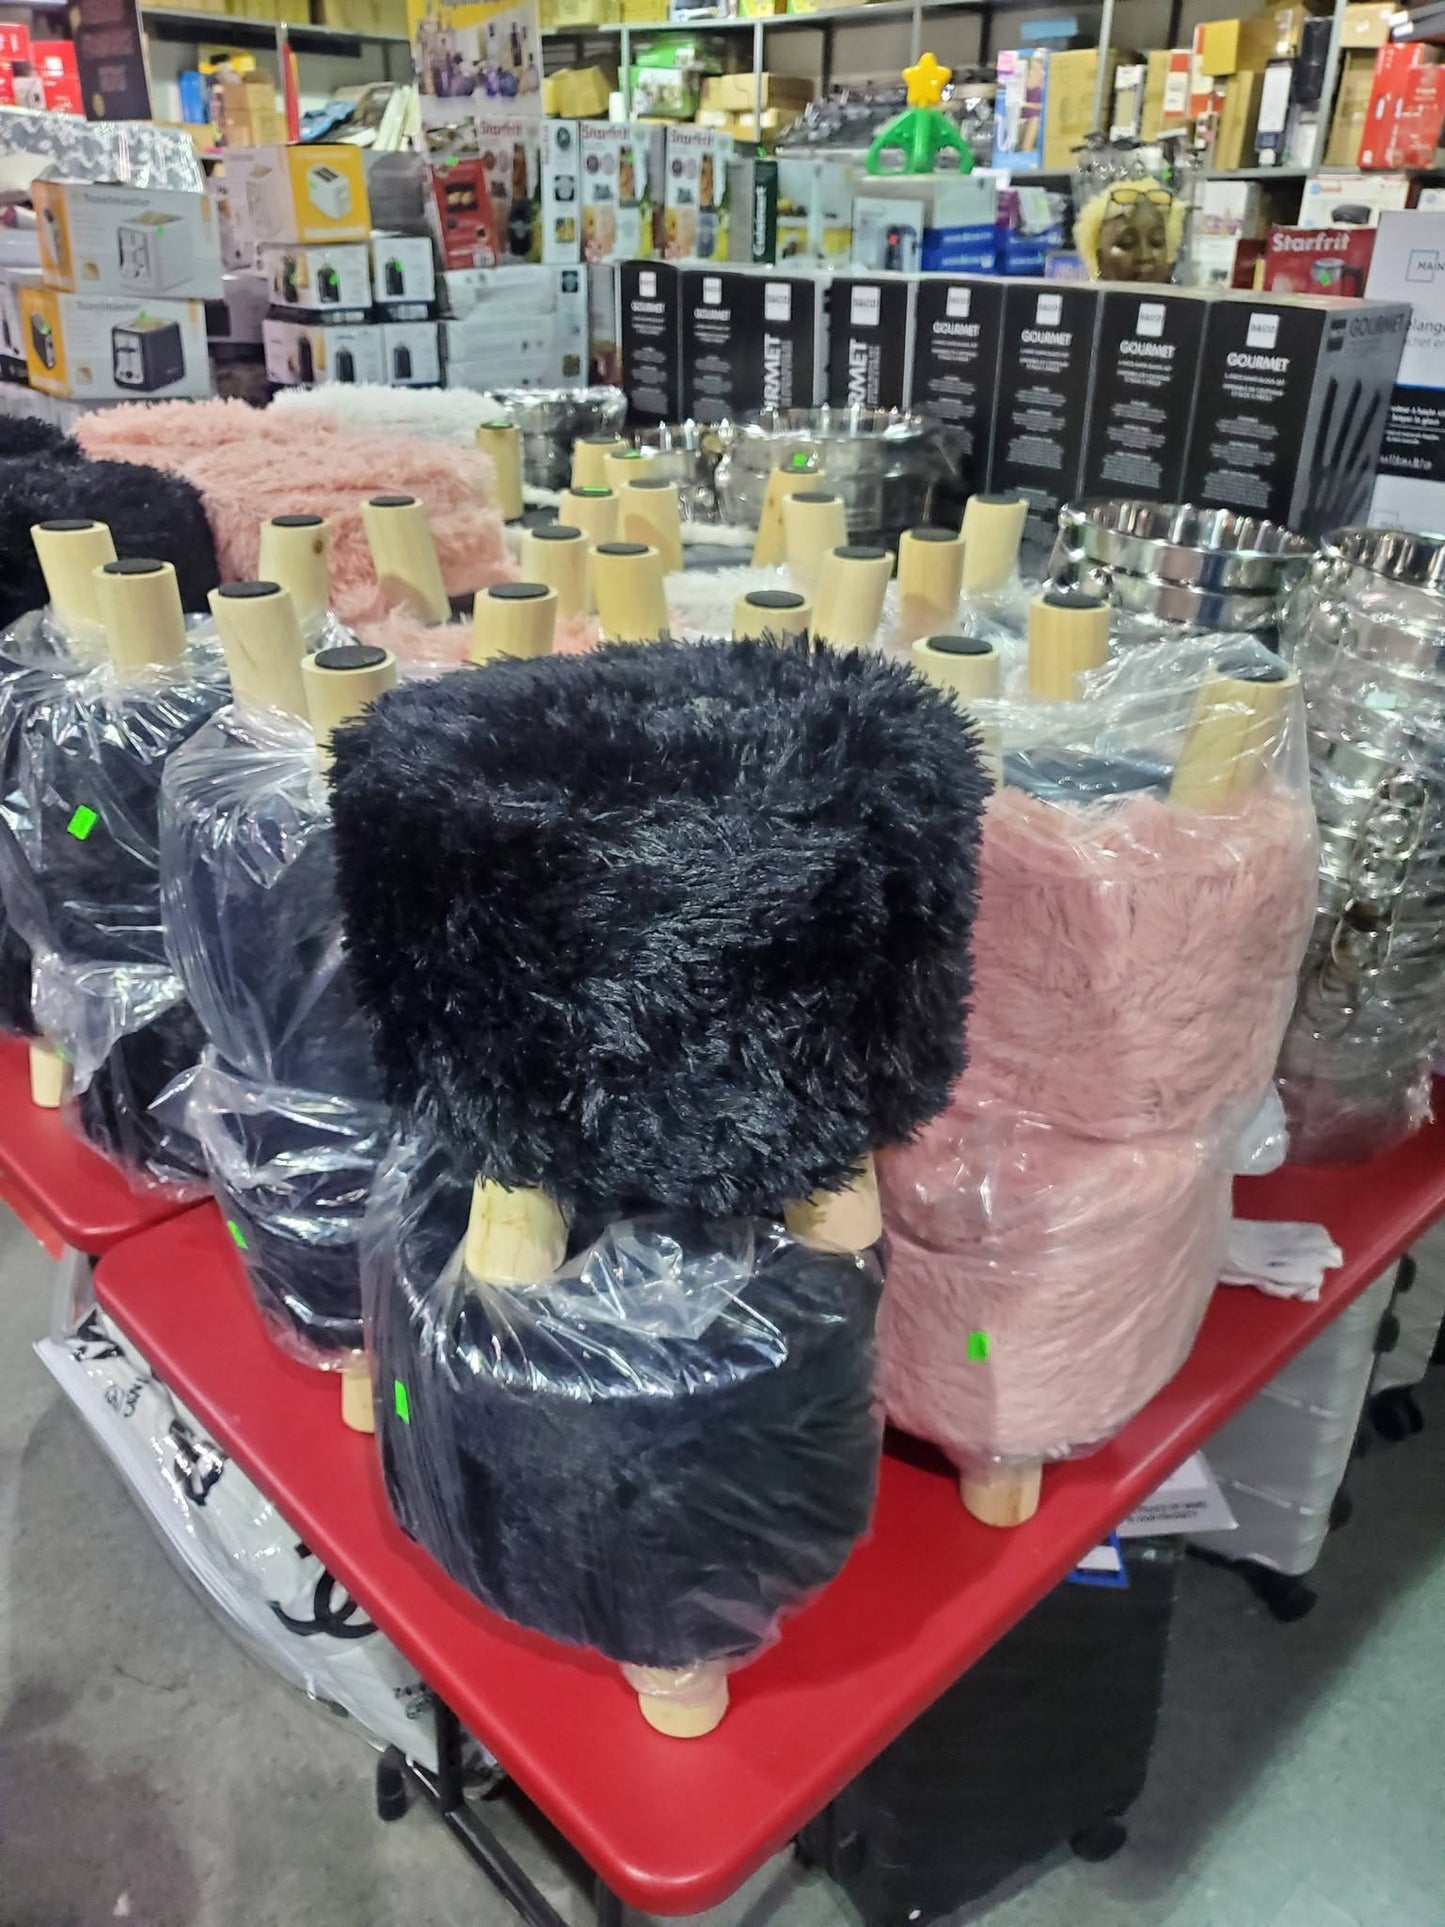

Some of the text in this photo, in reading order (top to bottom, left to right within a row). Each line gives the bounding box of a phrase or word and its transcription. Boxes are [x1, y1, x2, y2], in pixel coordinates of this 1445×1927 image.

[1272, 231, 1350, 252] Starfrit
[932, 321, 981, 337] GOURMET
[1350, 313, 1405, 338] GOURMET
[1021, 330, 1073, 346] GOURMET
[1119, 339, 1177, 359] GOURMET
[1226, 352, 1290, 373] GOURMET
